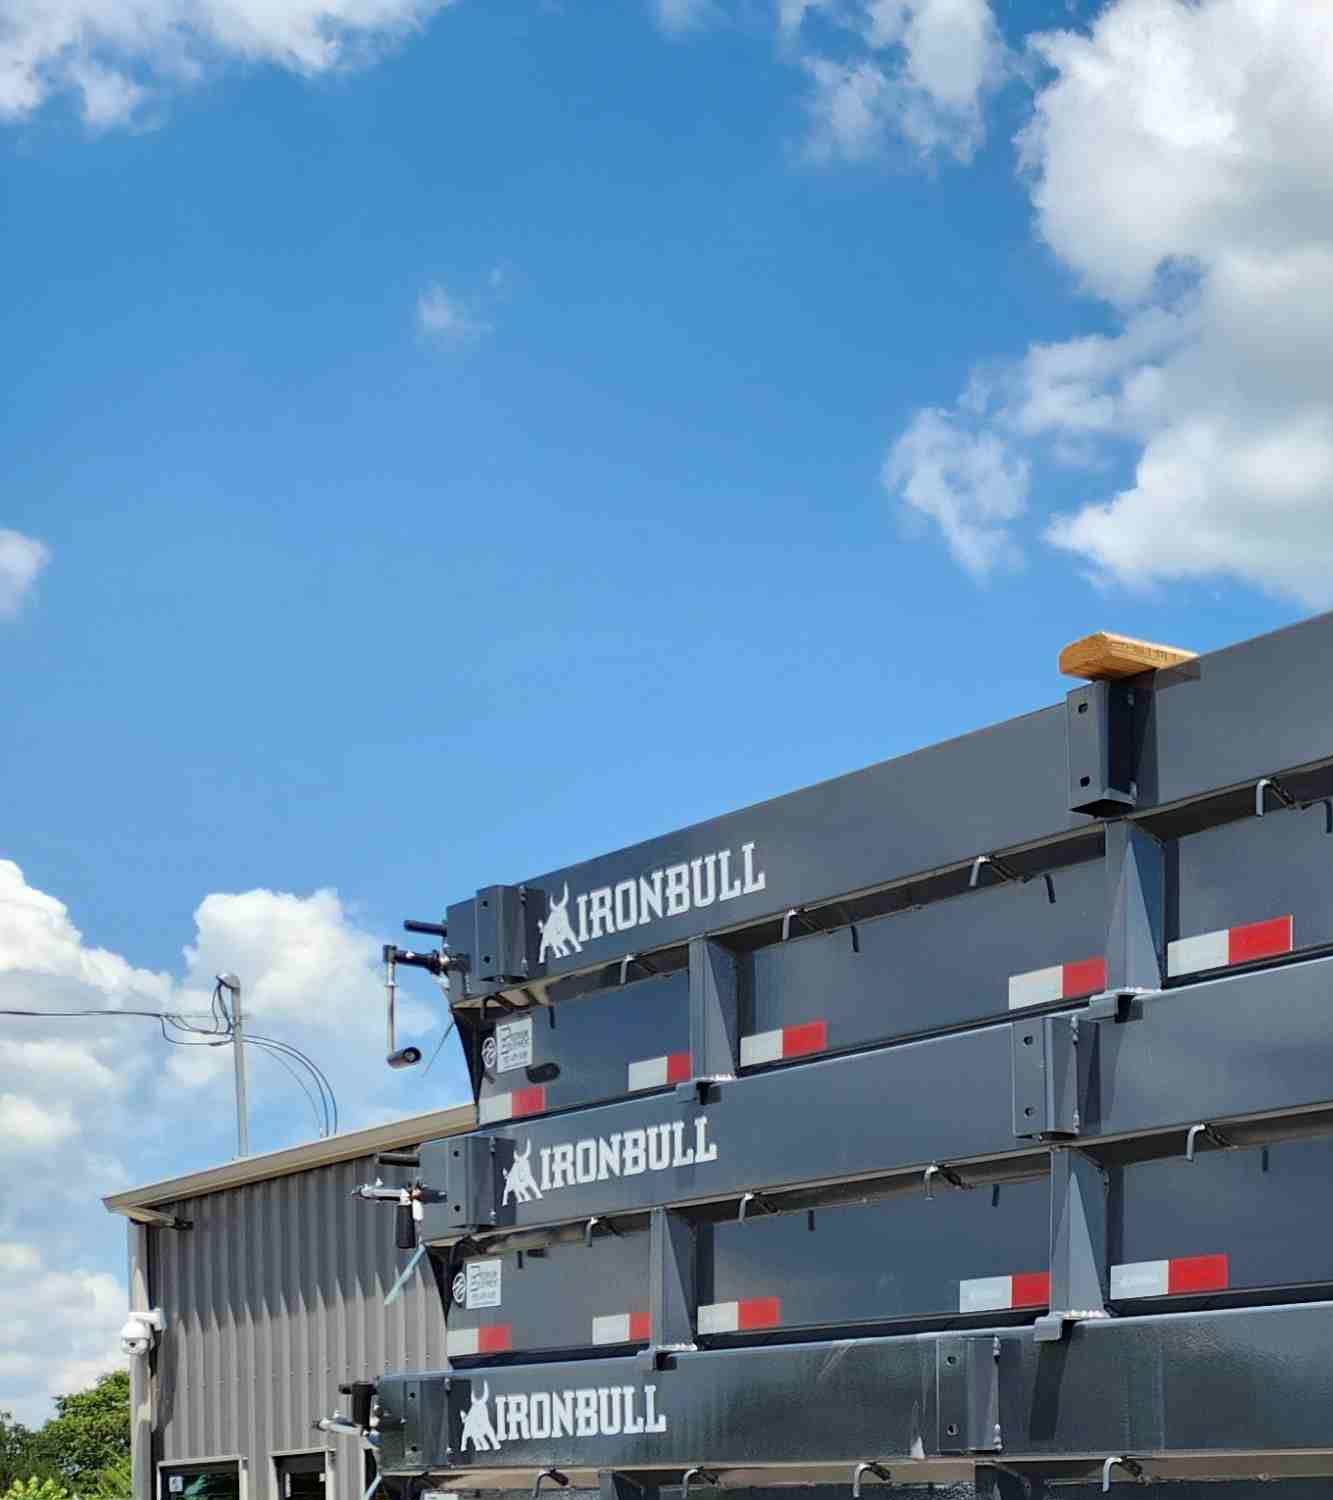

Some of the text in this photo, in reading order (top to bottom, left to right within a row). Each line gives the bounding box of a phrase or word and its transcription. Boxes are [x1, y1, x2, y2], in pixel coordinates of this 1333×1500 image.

[576, 842, 767, 943] IRONBULL
[540, 1115, 718, 1191] IRONBULL
[495, 1384, 667, 1442] IRONBULL
